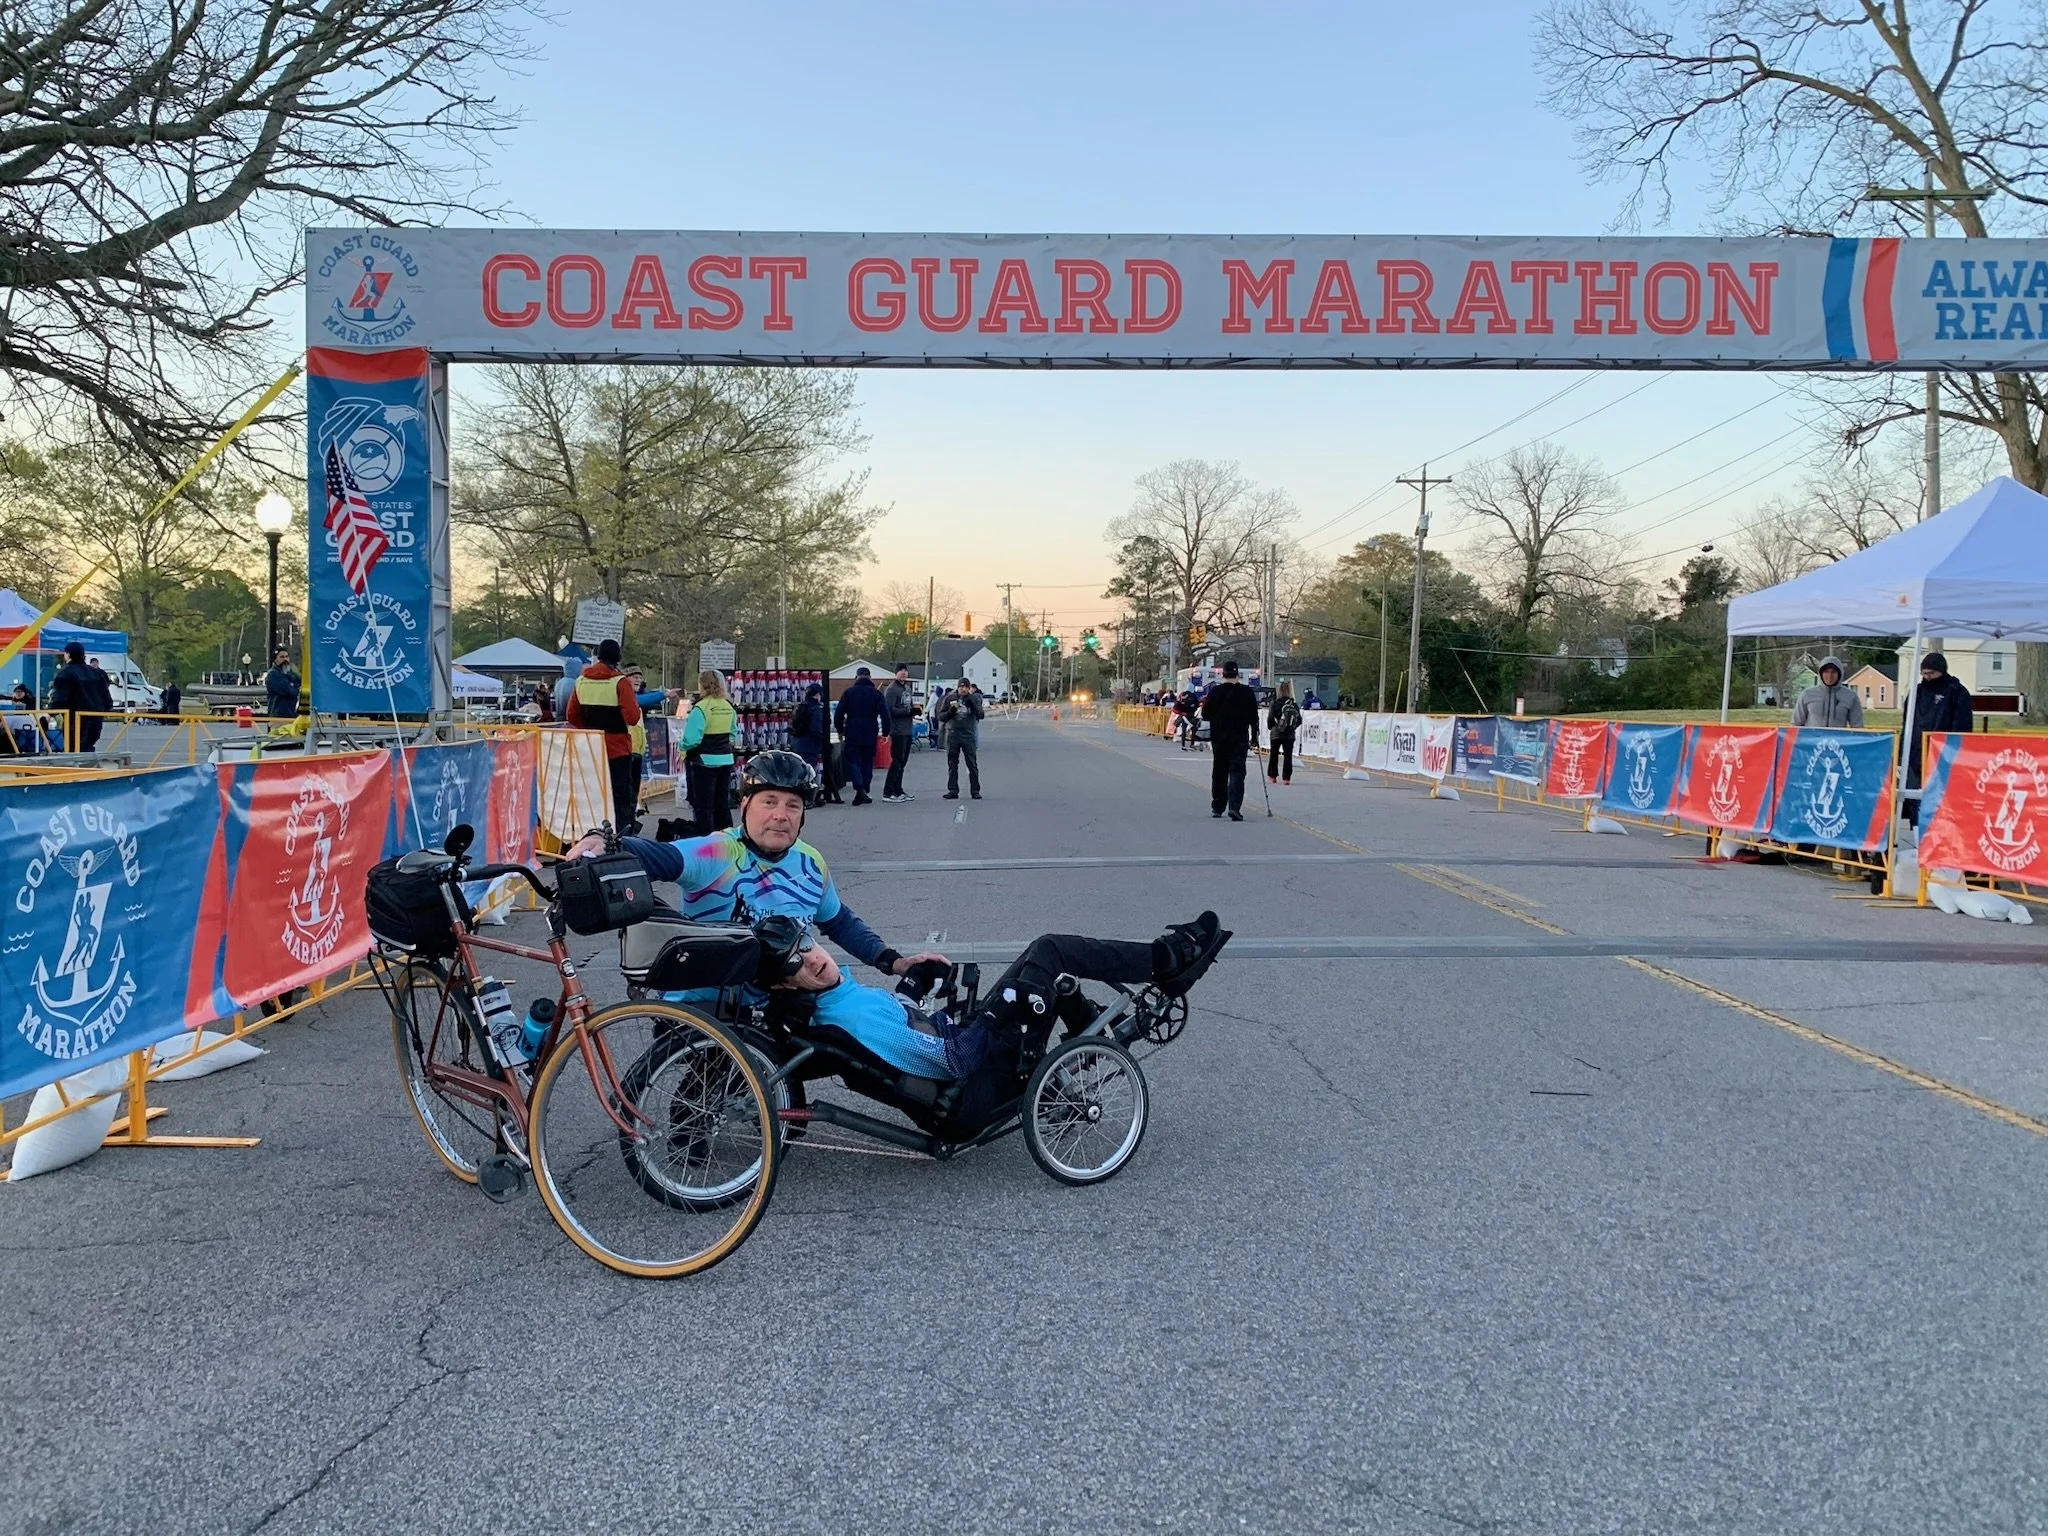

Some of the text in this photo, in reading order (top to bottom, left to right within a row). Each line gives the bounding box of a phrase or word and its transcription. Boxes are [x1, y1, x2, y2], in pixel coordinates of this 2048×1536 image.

[319, 235, 419, 278] COAST GUARD
[482, 254, 1778, 336] COAST GUARD MARATHON
[322, 315, 416, 345] MARATHON
[371, 502, 412, 510] STATES
[325, 531, 415, 547] GRD
[325, 593, 417, 631] COAST GUARD
[330, 663, 415, 690] MARATHON
[1806, 739, 1852, 778] COAST GUARD
[1976, 749, 2047, 798] COAST GUARD
[285, 776, 316, 856] COAST
[1804, 816, 1848, 839] MARATHON
[16, 803, 140, 913] COAST GUARD
[1977, 834, 2041, 871] MARATHON
[761, 908, 775, 916] THE
[281, 904, 345, 965] MARATHON
[17, 970, 138, 1060] MARATHON
